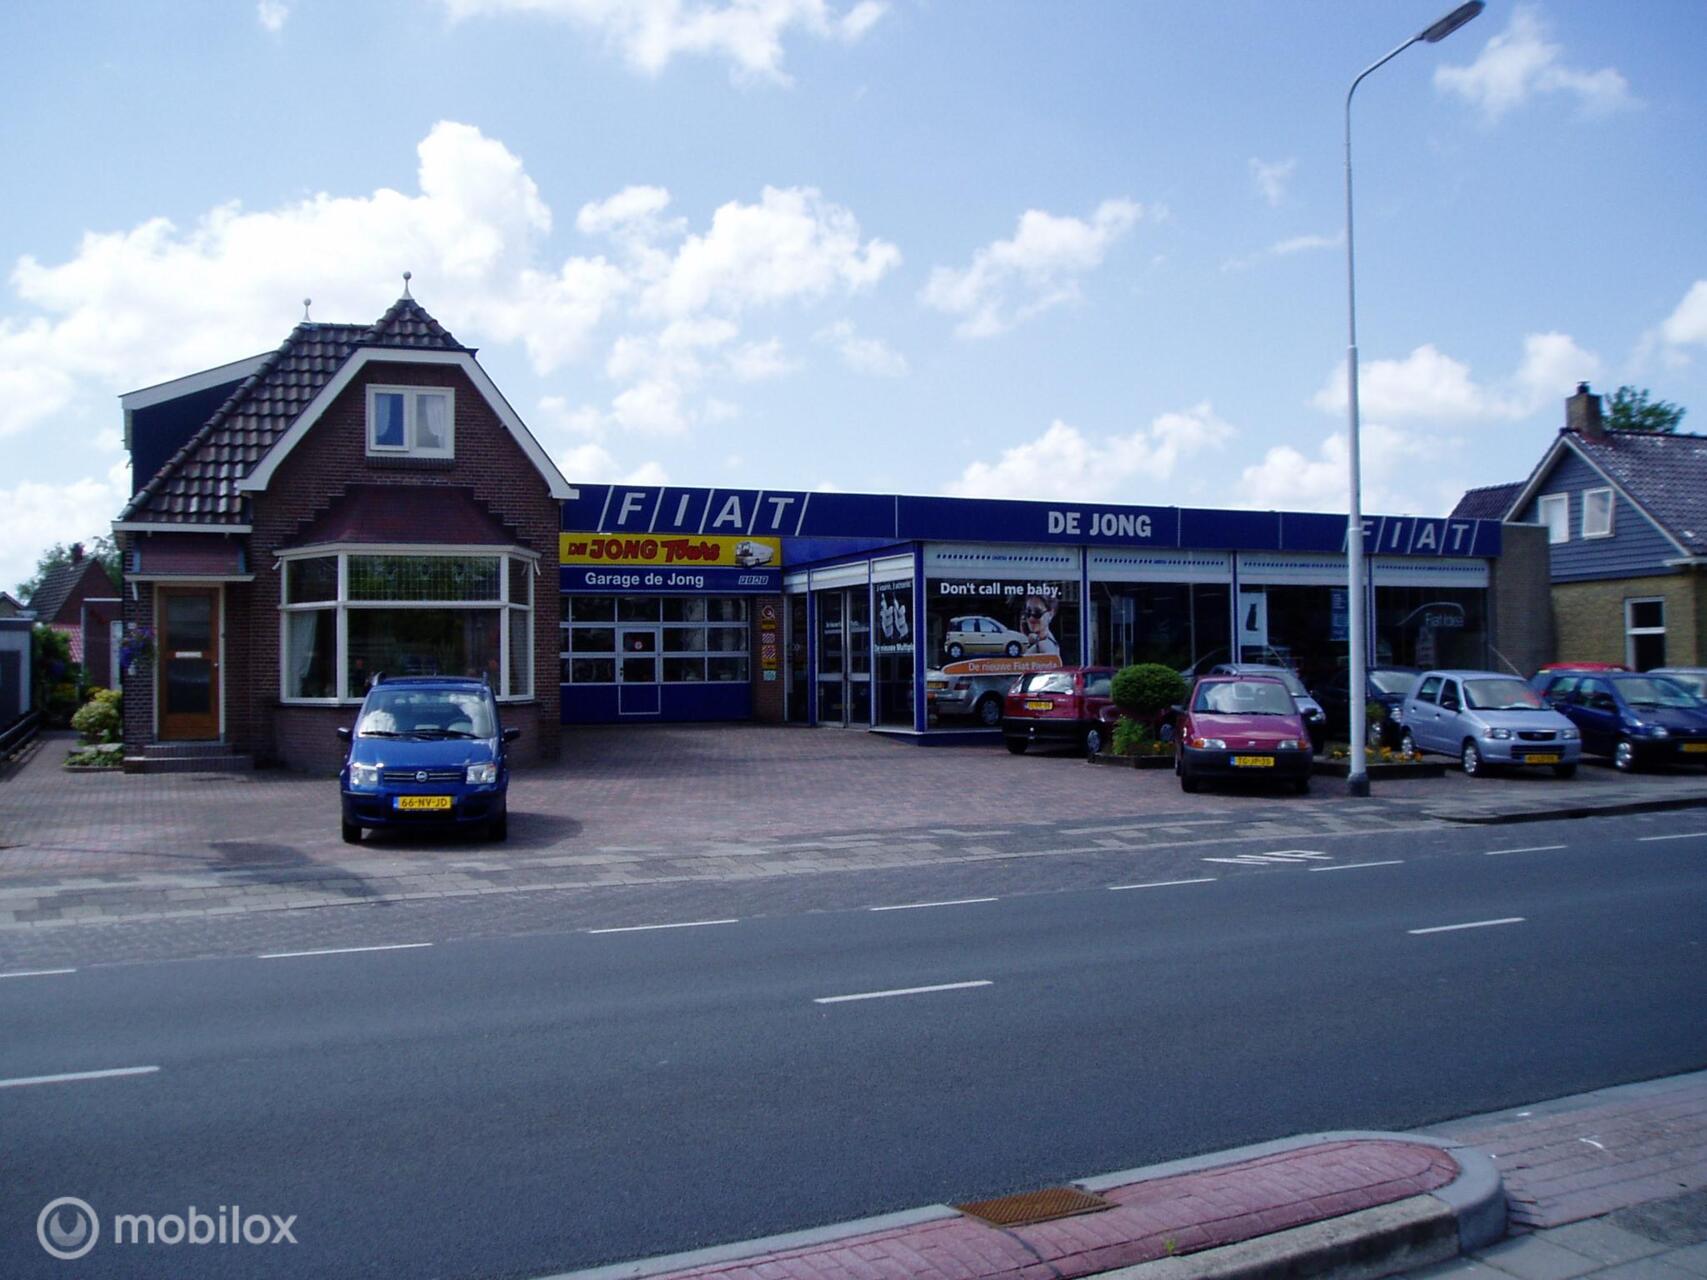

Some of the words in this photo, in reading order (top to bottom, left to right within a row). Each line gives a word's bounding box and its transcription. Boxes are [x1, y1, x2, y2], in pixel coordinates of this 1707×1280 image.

[617, 492, 794, 529] FIAT
[1048, 511, 1081, 534] DE
[1089, 513, 1152, 537] JONG
[589, 539, 658, 560] JONG
[585, 572, 640, 587] Garage
[645, 573, 663, 586] de
[668, 573, 704, 588] Jong
[940, 582, 975, 595] Don't
[979, 583, 1000, 595] call
[1004, 585, 1024, 596] me
[1027, 584, 1062, 599] baby.
[968, 663, 979, 671] De
